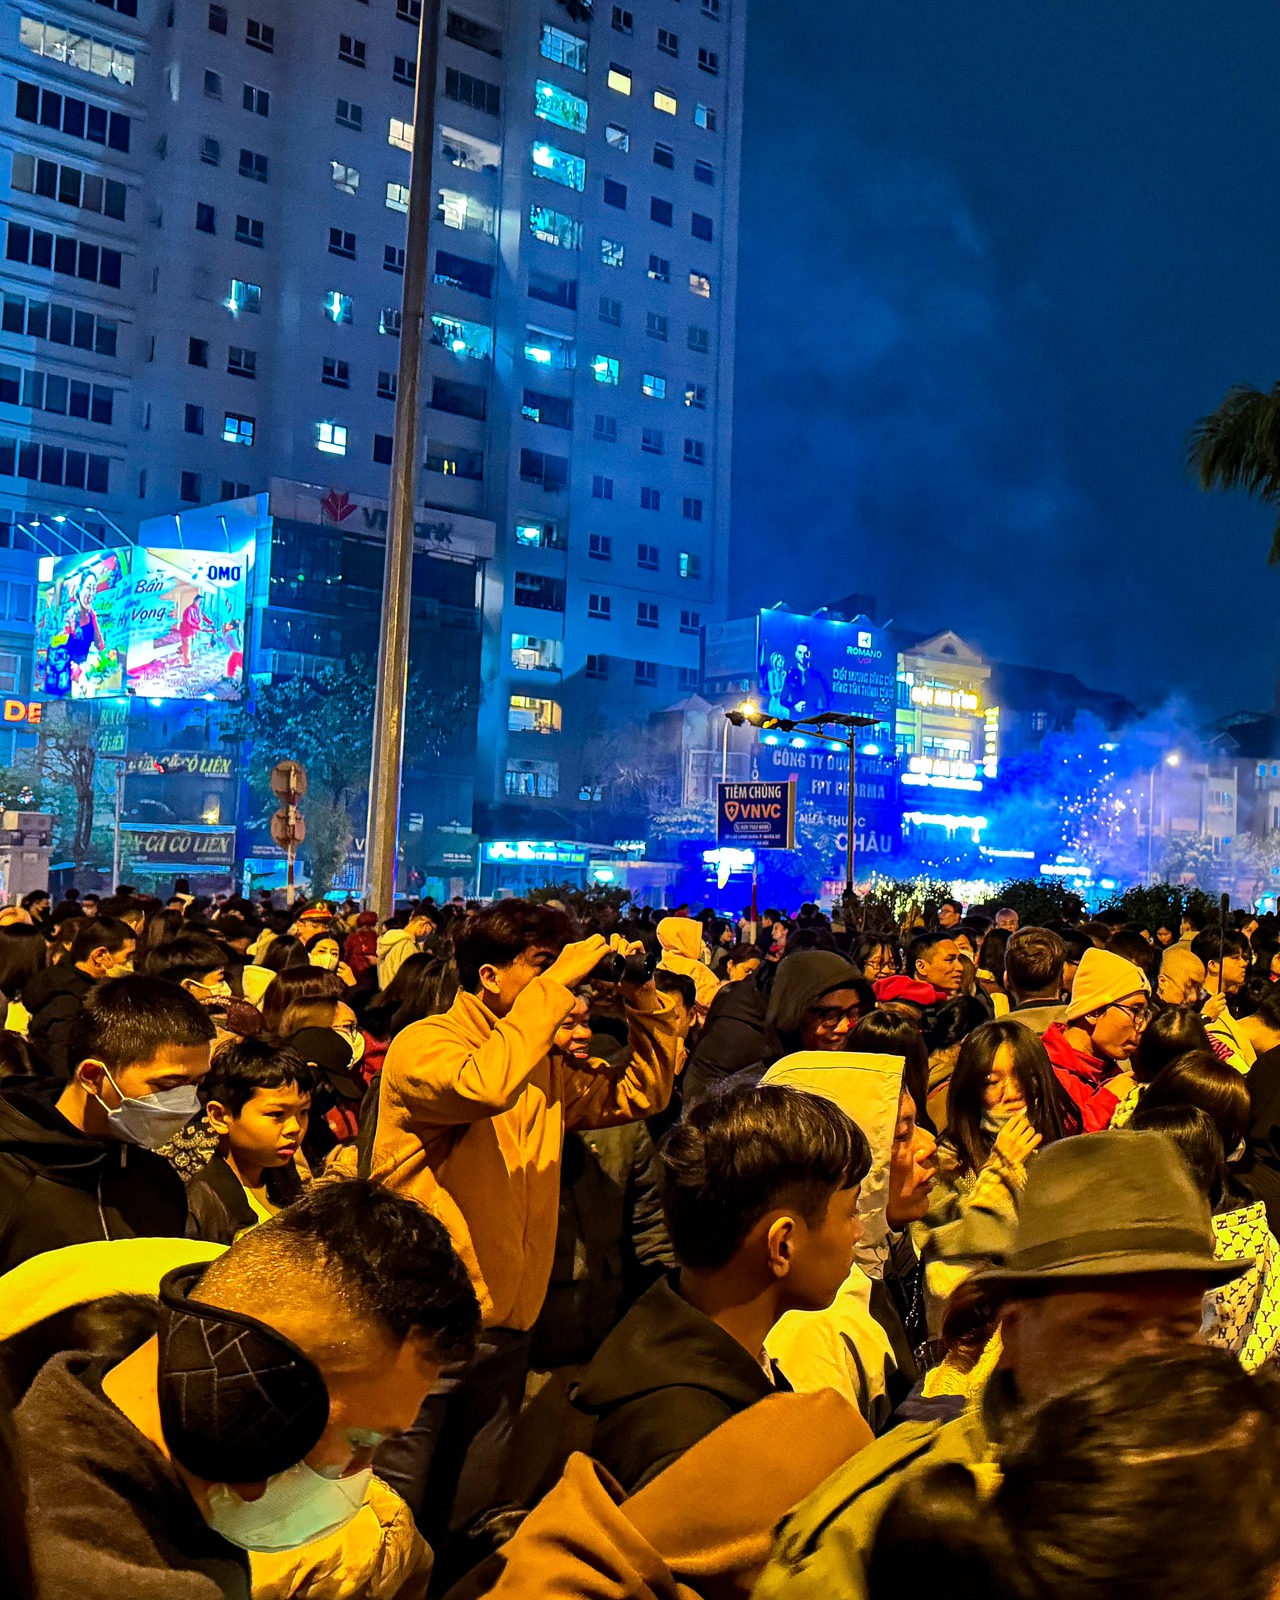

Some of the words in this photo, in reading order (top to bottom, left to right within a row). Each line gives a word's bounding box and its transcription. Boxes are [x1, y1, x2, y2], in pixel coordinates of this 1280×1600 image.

[207, 565, 241, 582] OMO
[131, 605, 167, 624] Vọng
[846, 645, 882, 658] ROMANO
[199, 754, 232, 774] LIÊN
[772, 748, 806, 768] CÔNG
[810, 754, 824, 770] TY
[724, 784, 747, 799] TIÊM
[749, 783, 782, 799] CHỦNG
[740, 803, 781, 819] VNVC
[193, 833, 231, 854] LIÊN
[835, 830, 892, 853] CHÂU
